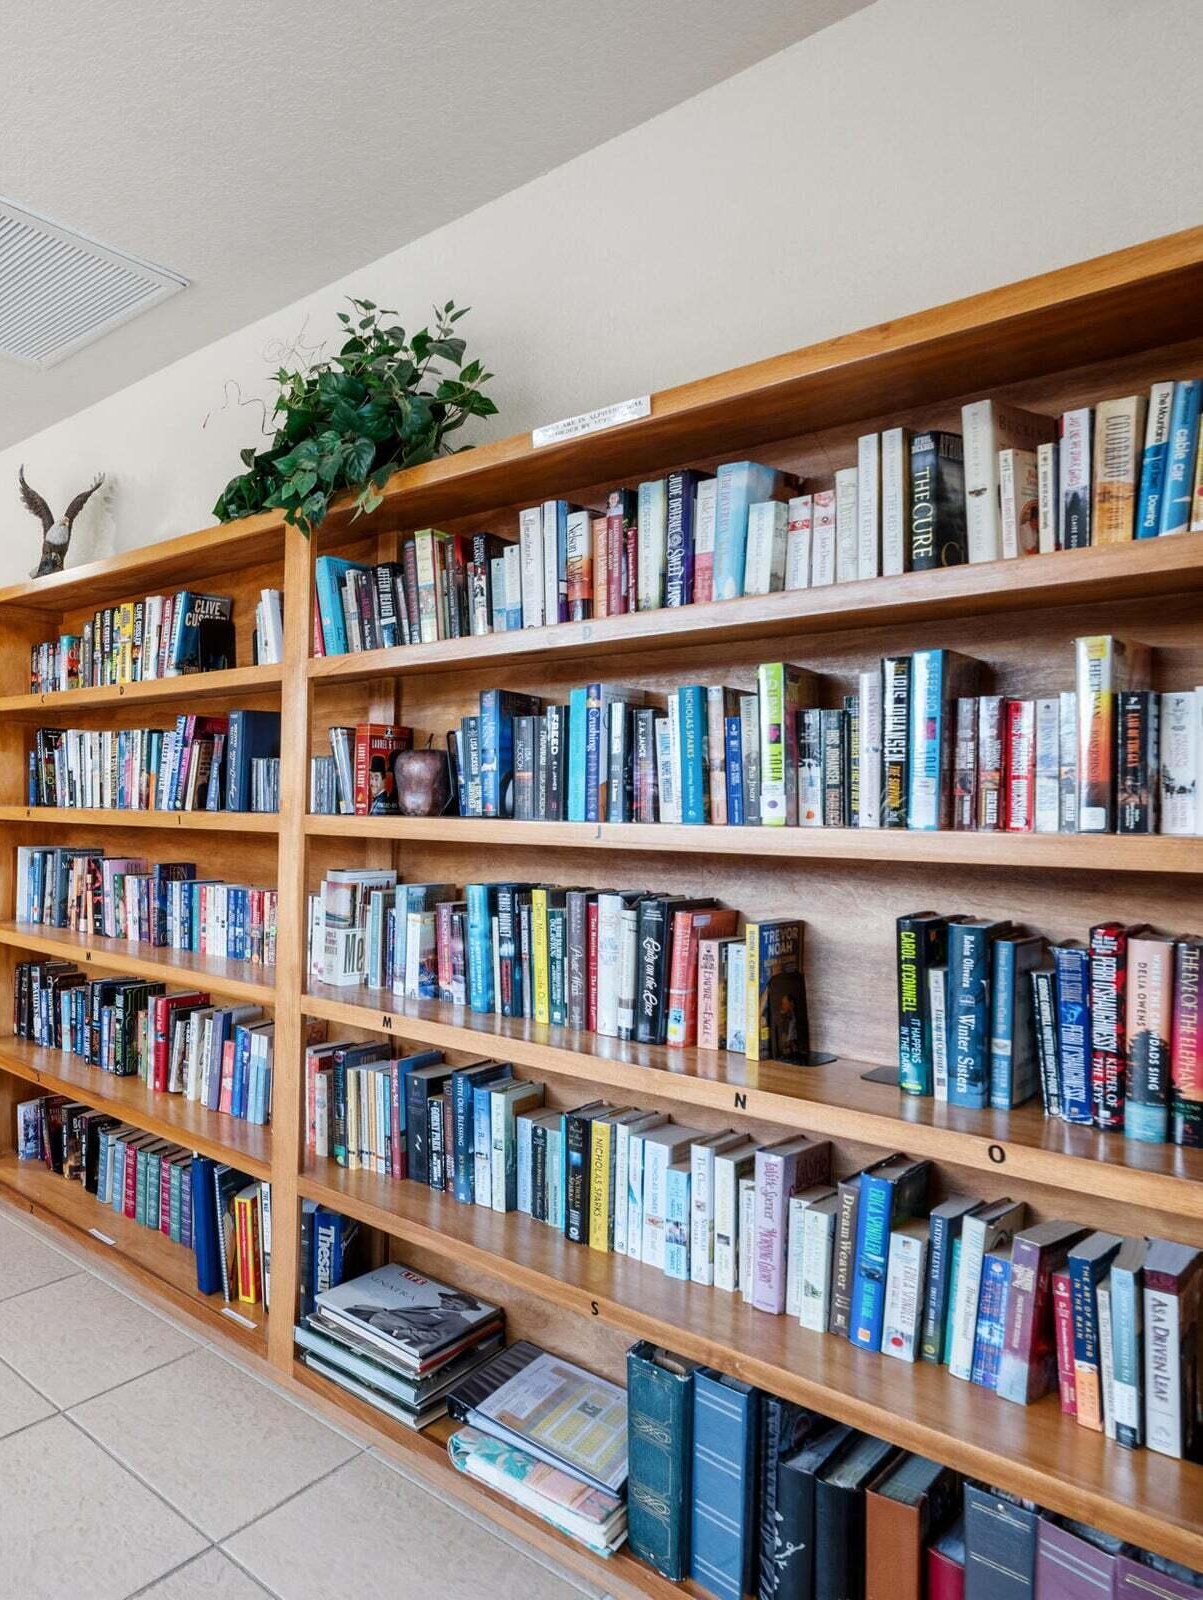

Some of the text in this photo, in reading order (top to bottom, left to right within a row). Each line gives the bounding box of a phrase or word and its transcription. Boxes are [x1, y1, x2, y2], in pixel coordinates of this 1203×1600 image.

[1155, 393, 1169, 443] The Mountains
[1104, 415, 1131, 478] COLORADO
[1172, 429, 1189, 481] cable car
[668, 475, 683, 499] JUDE
[668, 500, 684, 534] DEVERAUX
[912, 467, 934, 560] THE CURE
[1070, 515, 1079, 535] CLAIRE
[1144, 495, 1159, 527] Downing
[567, 523, 584, 587] Nelson DeMille
[195, 600, 221, 616] CLIVE
[377, 567, 395, 618] JEFFERY DEAVER
[926, 663, 937, 712] SLEEP NO
[550, 714, 559, 755] FREED
[587, 708, 598, 752] Crushing
[685, 689, 695, 759] NICHOLAS SPARKS
[884, 675, 907, 762] IRIS JOHANSEN
[357, 743, 366, 788] LAUREL HARDY
[470, 738, 480, 775] LISA JACKSON
[517, 740, 532, 770] LISA JACKSON
[826, 730, 840, 785] IRIS JOHANSEN
[498, 893, 512, 911] CHRIS
[86, 952, 92, 961] M
[536, 903, 546, 1005] Demi Moore Inside Out
[1182, 949, 1200, 971] THE
[643, 937, 661, 1017] Lady on the Case
[902, 932, 921, 1064] CAROL O'CONNELL IT HAPPENS
[997, 948, 1008, 1034] How Lucky You Can Be
[1136, 962, 1148, 1027] DELIA OWENS
[383, 1016, 392, 1028] M
[702, 970, 713, 1037] EMPIRE EAGLE
[957, 935, 974, 1094] Robin Oliveira Winter Sisters
[1147, 954, 1161, 1091] WHERE THE CRAWDADS SING
[1180, 1012, 1198, 1033] THE
[1181, 994, 1198, 1009] OF
[901, 1026, 910, 1073] IN THE DARK
[1037, 978, 1058, 1094] GEORGE ORWELL NINETEEN EIGHTY-FOUR
[1060, 954, 1086, 1103] MOVE TO STRIKE PERRI O'SHAUGHNESSY
[1091, 956, 1118, 1106] PERRI O'SHAUGHNESSY KEEPER OF
[734, 1092, 747, 1110] N
[1092, 1058, 1104, 1103] THE KEYS
[430, 1107, 442, 1152] GORKY PARK
[457, 1115, 465, 1146] BLESSING
[458, 1155, 465, 1163] JO
[593, 1136, 604, 1217] NICHOLAS SPARKS
[988, 1145, 1006, 1163] O
[568, 1175, 576, 1202] SPARKS
[574, 1174, 583, 1208] NICHOLAS
[758, 1188, 778, 1288] Spencer MORNING GLORY
[836, 1194, 855, 1290] Dream Weaver
[864, 1187, 885, 1255] ERICA SPINDLER
[932, 1218, 943, 1249] STATION
[317, 1225, 335, 1293] Thesau
[401, 1271, 429, 1287] LIFE
[930, 1250, 941, 1280] ELEVEN
[367, 1275, 416, 1303] SINATRA
[591, 1301, 600, 1316] S
[1074, 1278, 1084, 1339] IN THE RAIN
[1082, 1266, 1094, 1357] THE ART OF RACING
[1151, 1298, 1168, 1316] AS
[1152, 1326, 1169, 1372] DRIVEN
[1154, 1374, 1169, 1403] LEAF
